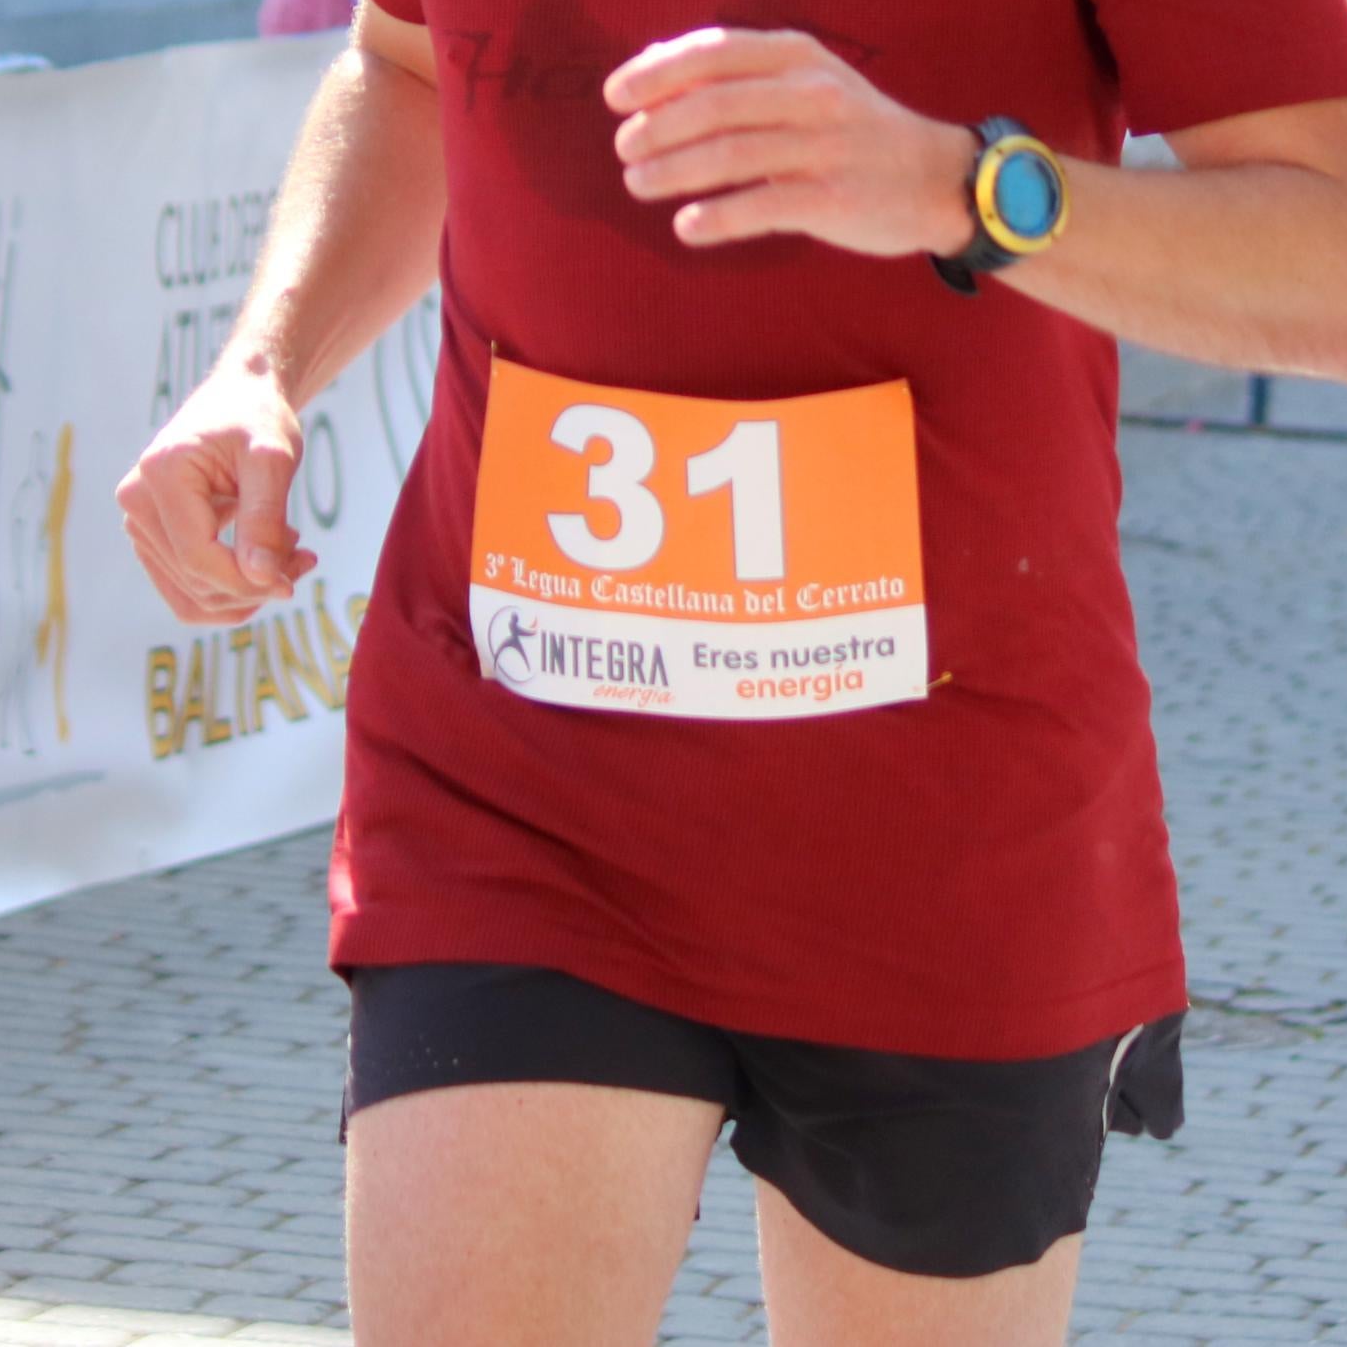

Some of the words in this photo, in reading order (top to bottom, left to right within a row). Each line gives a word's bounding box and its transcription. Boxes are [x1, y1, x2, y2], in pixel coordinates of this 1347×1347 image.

[547, 402, 786, 582] 31
[510, 556, 582, 599] Legua
[590, 574, 735, 614] Castellana
[743, 577, 786, 614] del
[795, 575, 906, 610] Cerrato
[540, 627, 669, 687] INTEGRA
[693, 641, 759, 670] Eres
[770, 633, 896, 670] nuestra
[736, 660, 865, 703] energía
